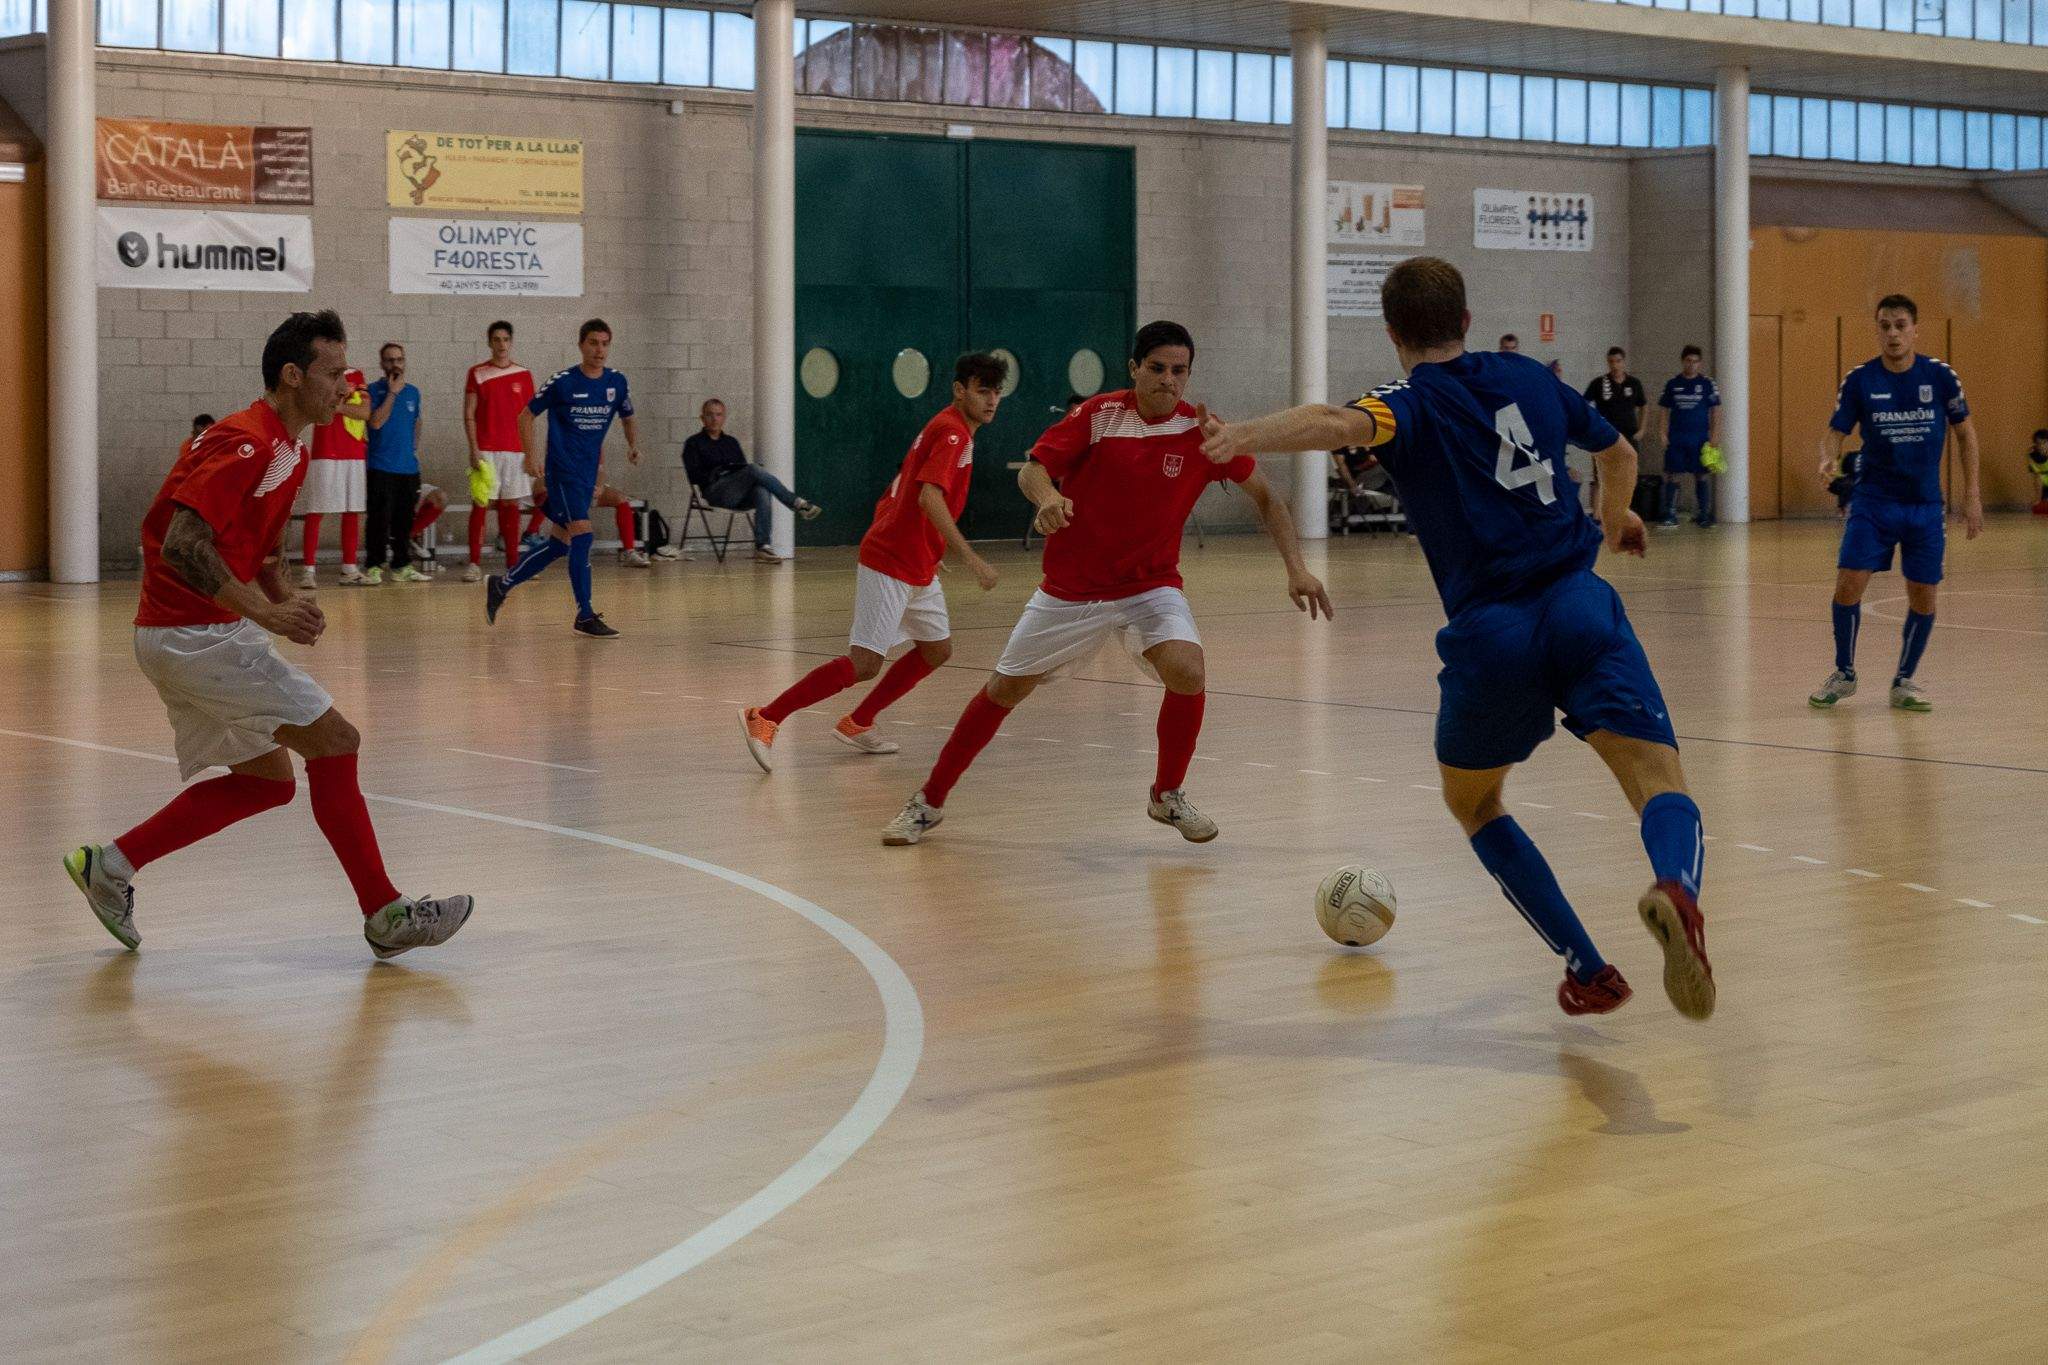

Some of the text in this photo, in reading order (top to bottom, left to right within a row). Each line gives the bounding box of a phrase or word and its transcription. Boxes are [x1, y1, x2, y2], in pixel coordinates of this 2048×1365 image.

[105, 132, 244, 170] CATALÀ
[436, 136, 580, 154] DE TOT PER A LA LLAR
[106, 177, 137, 195] Bar
[145, 180, 241, 200] Restaurant
[439, 225, 537, 246] OLIMPYC
[157, 232, 286, 272] hummel
[434, 249, 543, 270] F40RESTA
[1495, 402, 1557, 505] 4
